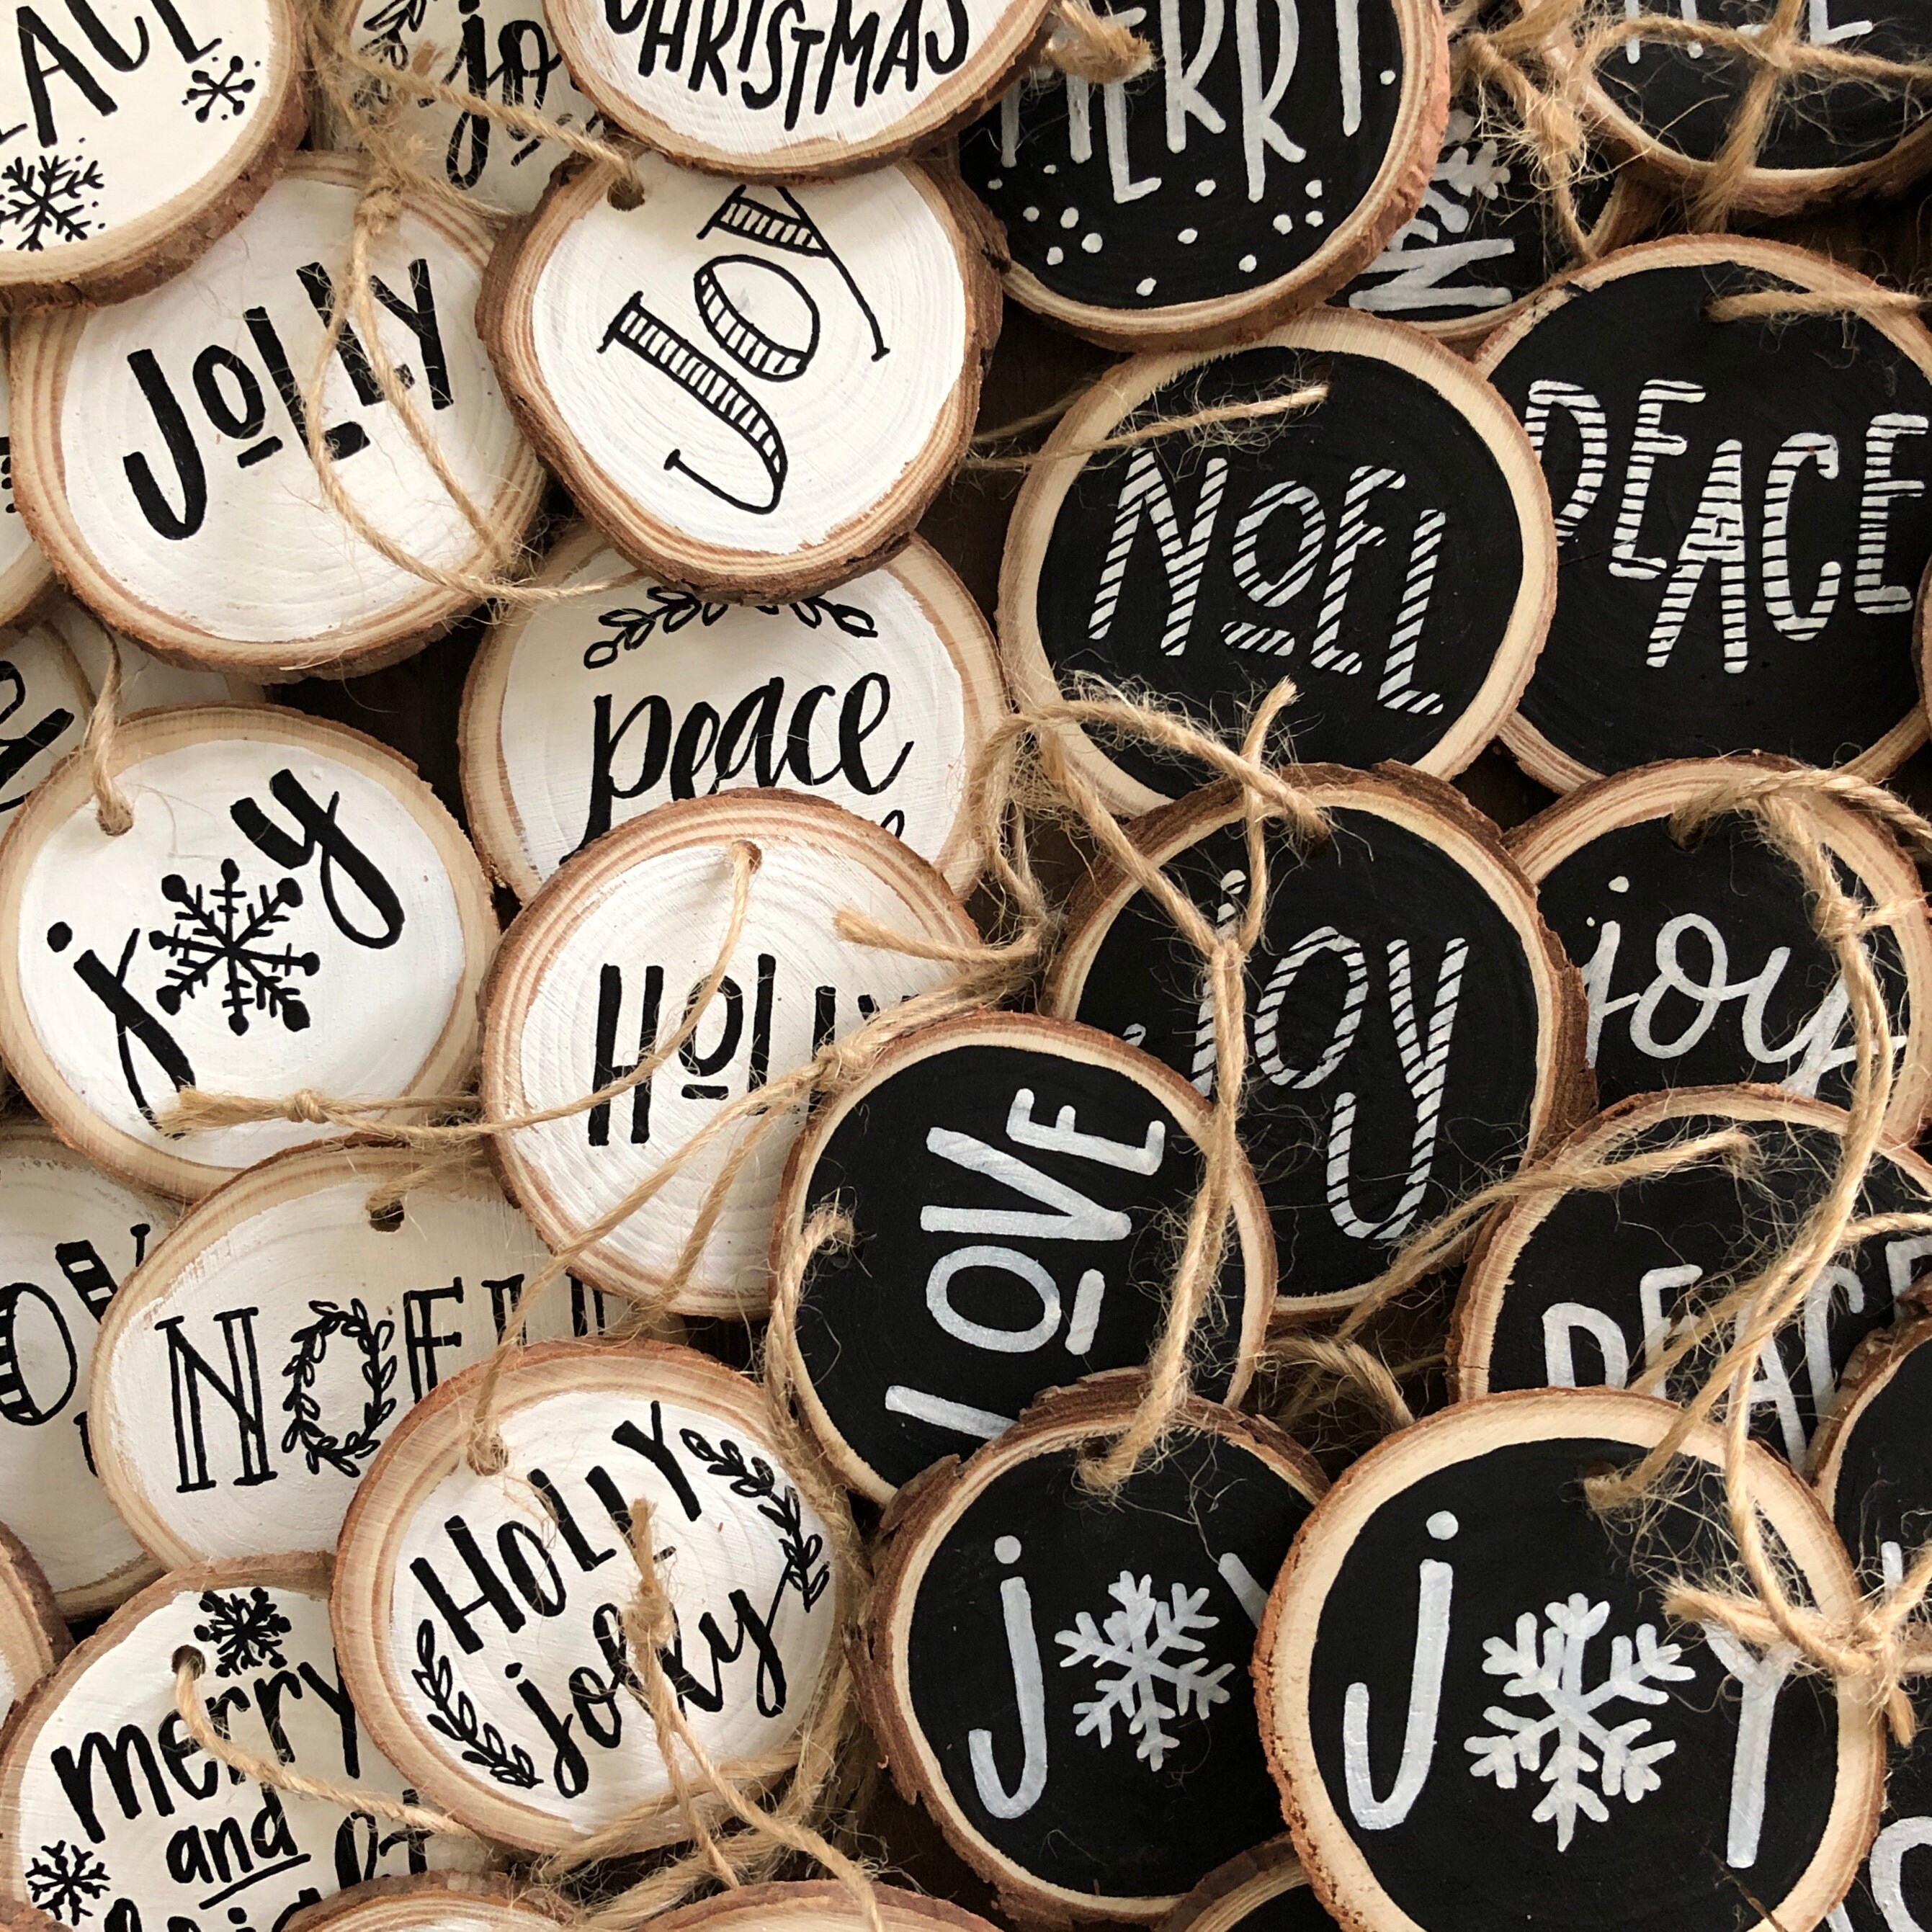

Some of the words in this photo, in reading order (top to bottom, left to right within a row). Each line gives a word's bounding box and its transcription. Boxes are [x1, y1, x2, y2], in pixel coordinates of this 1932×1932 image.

[123, 259, 452, 540] JOLLY
[1523, 380, 1929, 674] PEACE
[1088, 447, 1446, 715] NOEL
[559, 671, 915, 865] peace
[409, 1400, 702, 1655] HOLLY
[166, 1782, 300, 1883] and
